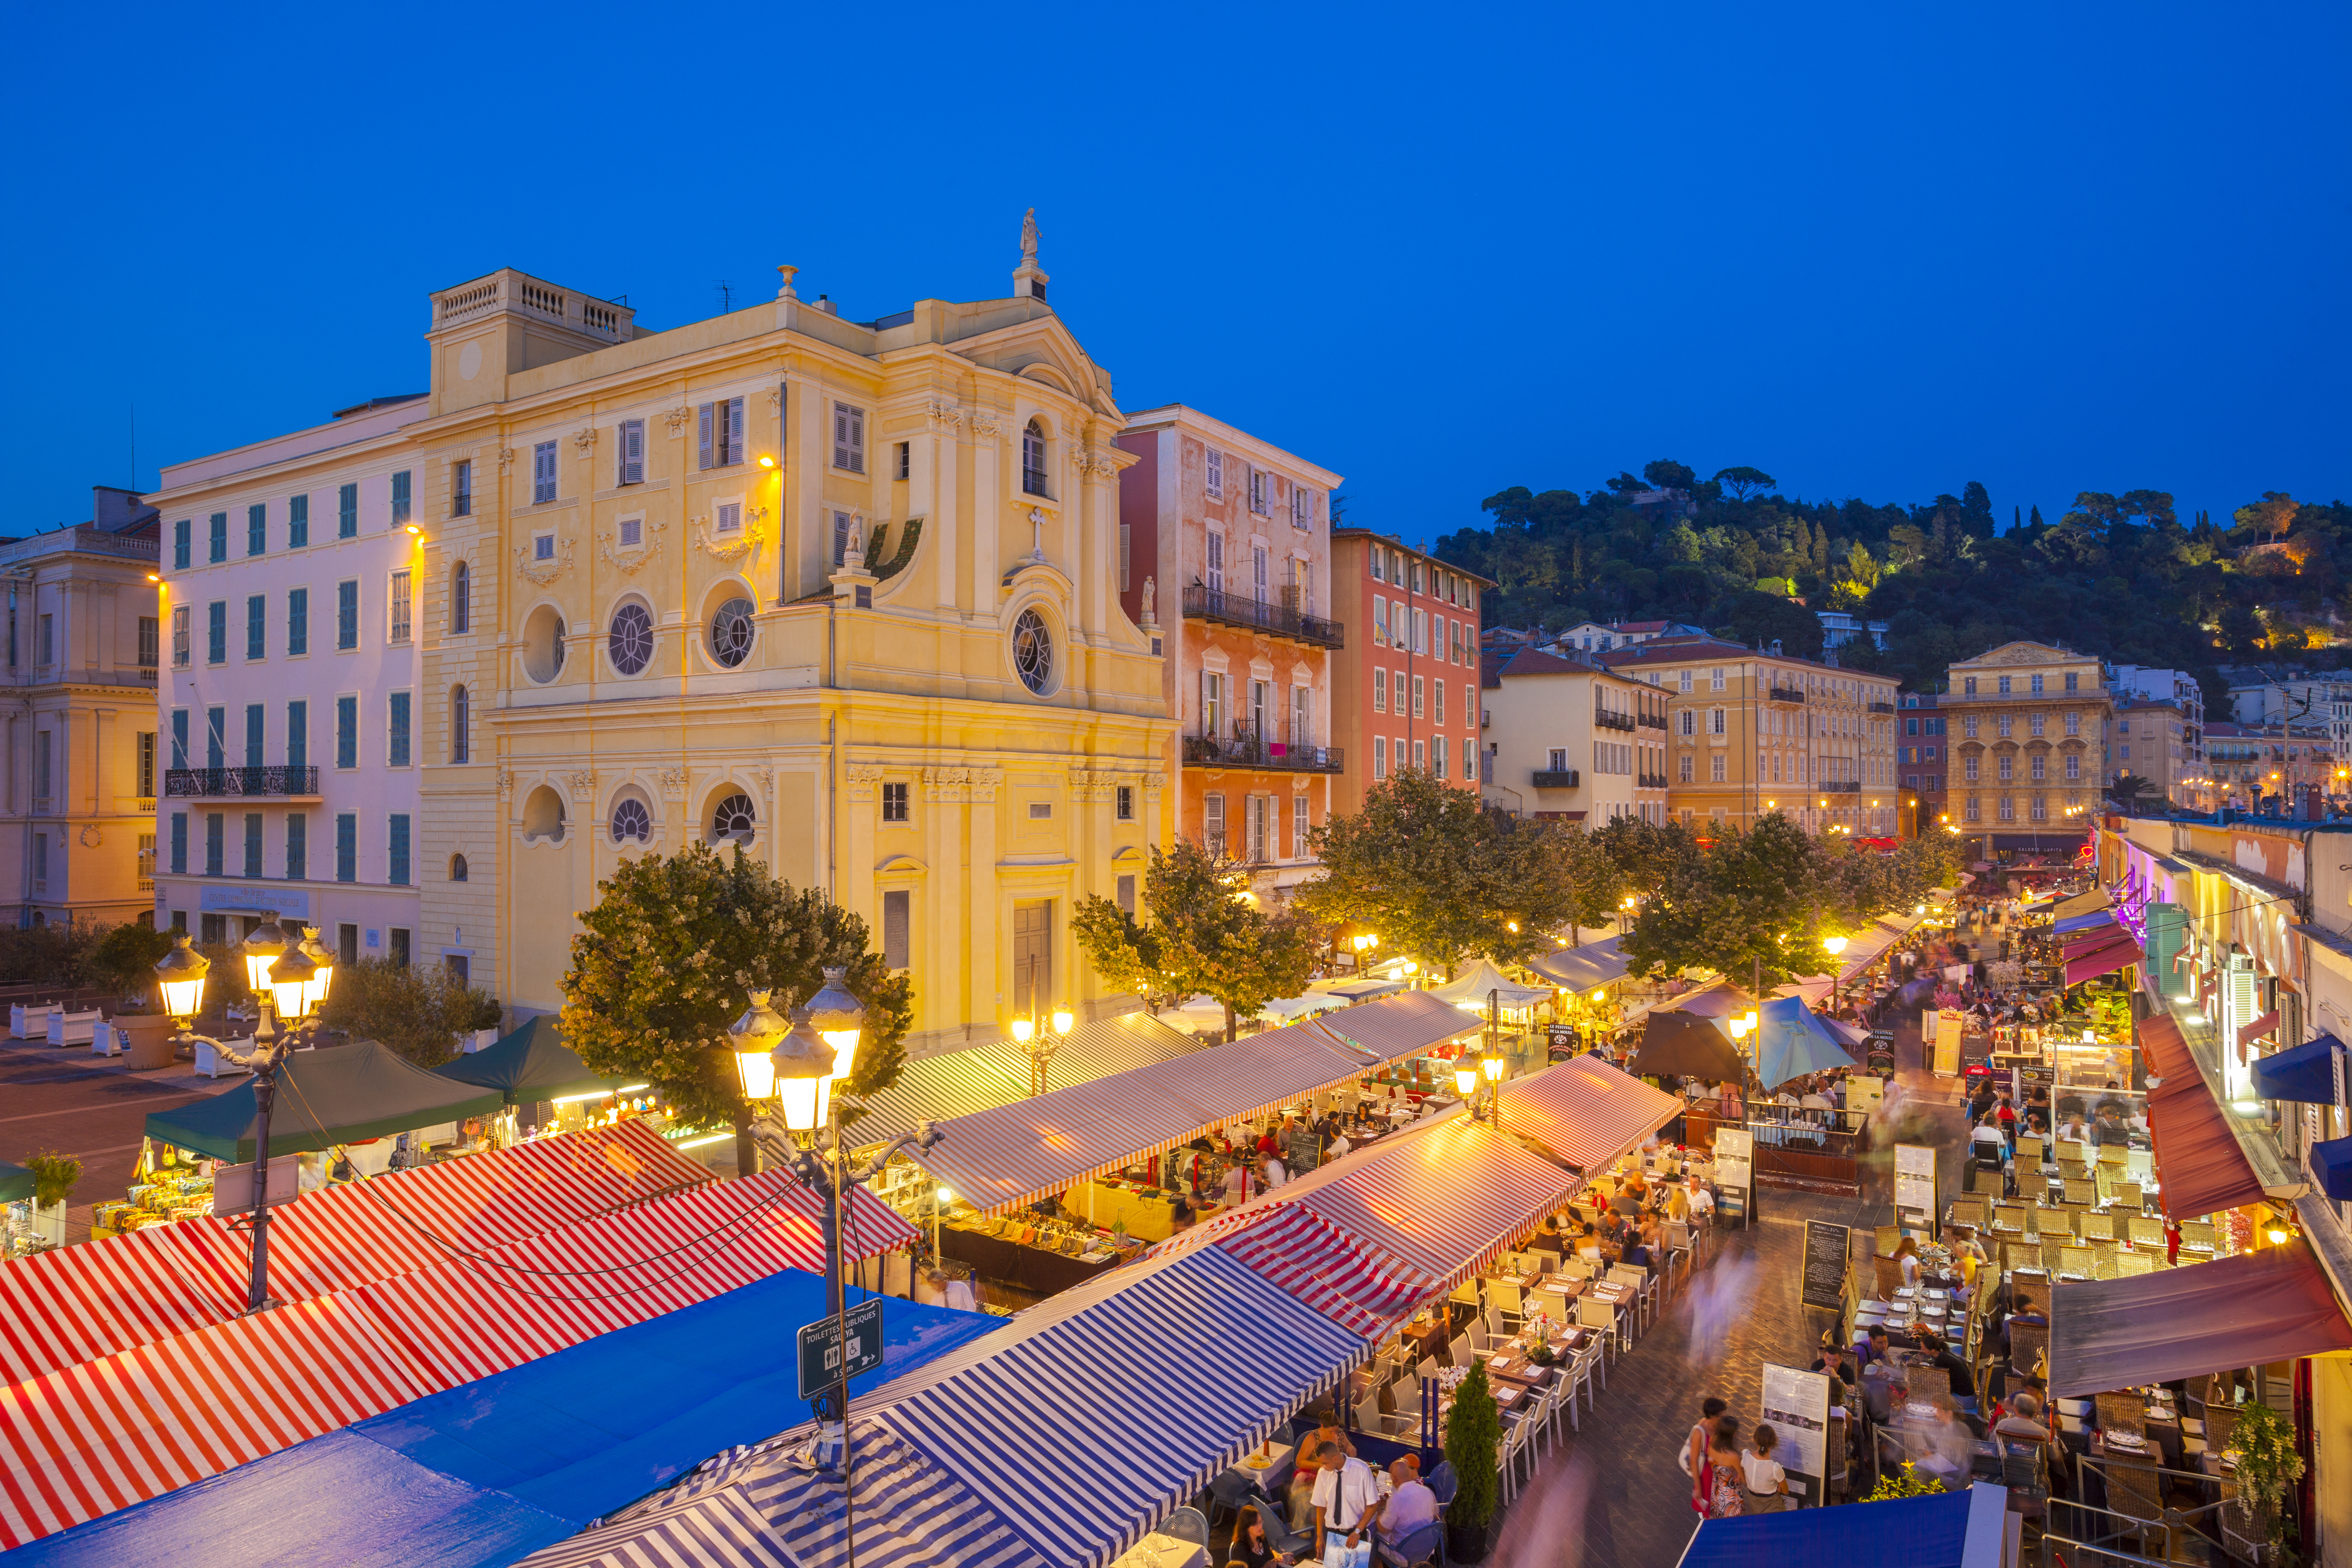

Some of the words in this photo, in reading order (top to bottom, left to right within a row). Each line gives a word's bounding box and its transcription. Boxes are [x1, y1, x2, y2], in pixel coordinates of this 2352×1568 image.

[209, 894, 226, 902] CENTRE
[228, 895, 253, 905] COMMUNAL
[255, 897, 277, 905] D'ACTION
[279, 898, 299, 907] SOCIALE
[806, 1324, 840, 1344] TOILETTES
[830, 1328, 854, 1344] SALYA
